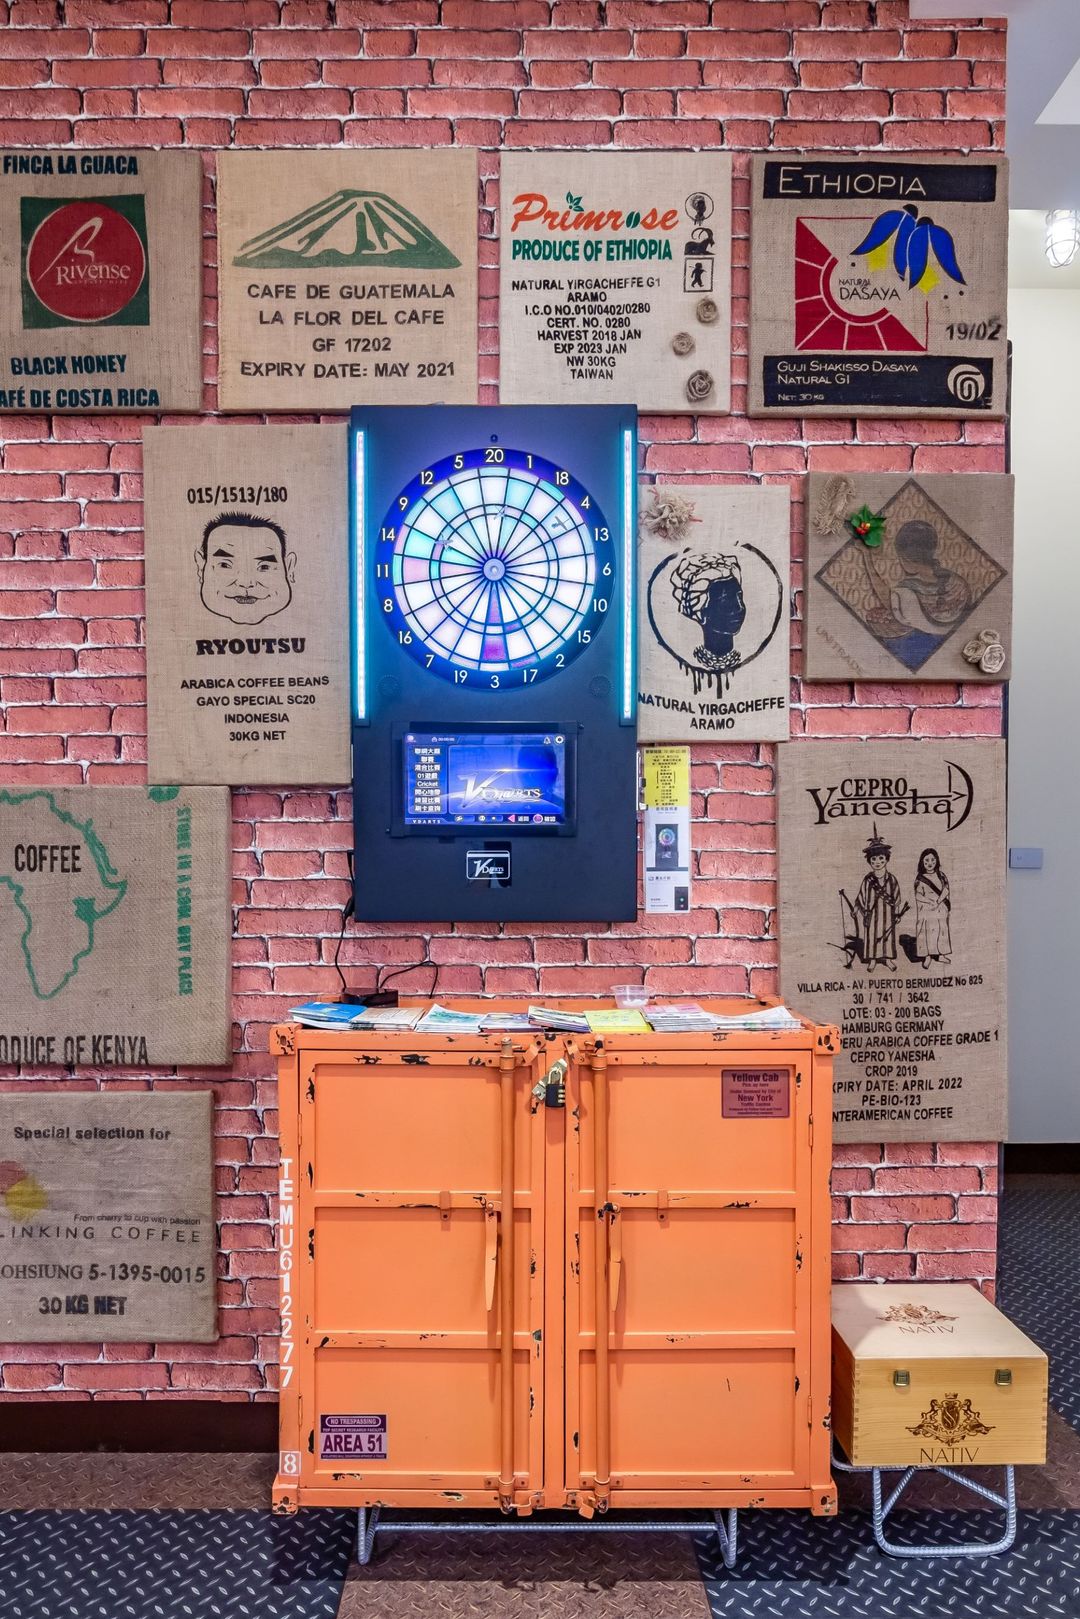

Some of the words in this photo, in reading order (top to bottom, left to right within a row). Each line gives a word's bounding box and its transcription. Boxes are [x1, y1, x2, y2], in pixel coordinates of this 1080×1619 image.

[3, 156, 53, 175] FINCA
[58, 156, 77, 174] LA
[81, 156, 138, 175] GUACA
[511, 193, 679, 231] Primrose
[512, 240, 580, 260] PRODUCE
[584, 241, 601, 261] OF
[606, 240, 672, 261] ETHIOPIA
[56, 259, 131, 285] Rivense
[512, 279, 564, 291] NATURAL
[568, 278, 644, 290] YIRGACHEFFE
[647, 277, 660, 287] G1
[839, 278, 870, 286] NATURAL
[248, 284, 296, 299] CAFE
[306, 285, 330, 299] DE
[340, 284, 455, 299] GUATEMALA
[568, 292, 607, 302] ARAMO
[840, 287, 900, 300] DASAYA
[260, 311, 283, 324] LA
[294, 311, 341, 325] FLOR
[352, 311, 387, 325] DEL
[395, 310, 444, 324] CAFE
[547, 318, 579, 328] CERT.
[583, 318, 602, 328] NO.
[605, 317, 630, 327] 0280
[538, 330, 588, 341] HARVEST
[593, 331, 616, 341] 2018
[621, 329, 641, 340] JAN
[313, 338, 335, 352] GF
[345, 338, 391, 352] 17202
[554, 343, 574, 354] EXP
[578, 343, 602, 354] 2023
[606, 343, 626, 354] JAN
[11, 357, 68, 375] BLACK
[72, 355, 126, 373] HONEY
[567, 357, 584, 366] NW
[588, 357, 616, 367] 30KG
[241, 362, 305, 376] EXPIRY
[314, 363, 368, 378] DATE:
[375, 363, 410, 377] MAY
[417, 362, 454, 378] 2021
[571, 369, 613, 380] TAIWAN
[30, 390, 50, 407] DE
[56, 389, 113, 407] COSTA
[121, 389, 159, 406] RICA
[455, 456, 463, 469] 5
[485, 450, 503, 462] 20
[421, 472, 433, 484] 12
[556, 472, 568, 485] 18
[187, 485, 287, 505] 015/1513/180
[400, 498, 408, 510] 9
[581, 497, 590, 508] 4
[382, 529, 395, 541] 14
[595, 529, 608, 541] 13
[377, 565, 388, 577] 11
[603, 563, 611, 576] 6
[384, 599, 392, 613] 8
[593, 599, 607, 612] 10
[399, 631, 412, 643] 16
[578, 631, 590, 643] 15
[196, 638, 305, 655] RYOUTSU
[426, 655, 434, 667] 7
[556, 655, 564, 667] 2
[181, 678, 235, 689] ARABICA
[238, 678, 284, 688] COFFEE
[289, 676, 329, 686] BEANS
[455, 671, 468, 683] 19
[491, 676, 499, 688] 3
[524, 670, 538, 683] 17
[197, 696, 229, 706] GAYO
[234, 695, 283, 706] SPECIAL
[287, 695, 315, 705] SC20
[638, 693, 695, 714] NATURAL
[698, 697, 785, 715] YIRGACHEFFE
[225, 713, 289, 723] INDONESIA
[690, 718, 734, 729] ARAMO
[230, 731, 259, 741] 30KG
[264, 731, 286, 740] NET
[841, 778, 907, 798] CEPRO
[806, 786, 954, 824] Yanesha
[176, 807, 192, 849] STORE
[15, 844, 81, 872] COFFEE
[176, 855, 192, 870] IN
[176, 874, 192, 884] A
[798, 982, 822, 993] VILLA
[825, 981, 844, 992] RICA
[869, 979, 903, 989] PUERTO
[906, 977, 953, 989] BERMUDEZ
[969, 975, 983, 985] 825
[853, 994, 863, 1004] 30
[878, 993, 893, 1004] 741
[908, 992, 929, 1002] 3642
[843, 1008, 872, 1020] LOTE:
[875, 1007, 886, 1018] 03
[895, 1007, 910, 1018] 200
[914, 1006, 941, 1018] BAGS
[842, 1022, 892, 1034] HAMBURG
[895, 1020, 944, 1032] GERMANY
[865, 1037, 910, 1049] ARABICA
[914, 1034, 952, 1047] COFFEE
[956, 1031, 990, 1044] GRADE
[64, 1036, 85, 1064] OF
[92, 1035, 148, 1064] KENYA
[851, 1052, 885, 1063] CEPRO
[889, 1050, 935, 1062] YANESHA
[731, 1073, 760, 1082] Yellow
[762, 1073, 779, 1081] Cab
[865, 1066, 893, 1077] CROP
[897, 1066, 917, 1076] 2019
[833, 1082, 862, 1094] PIRY
[866, 1080, 899, 1092] DATE:
[902, 1079, 934, 1091] APRIL
[939, 1078, 962, 1089] 2022
[862, 1095, 921, 1106] PE-BIO-123
[832, 1109, 910, 1122] NTERAMERICAN
[914, 1107, 953, 1118] COFFEE
[14, 1127, 69, 1141] Special
[76, 1127, 144, 1140] selection
[150, 1127, 171, 1140] for
[0, 1226, 95, 1239] INKING
[112, 1226, 200, 1243] COFFEE
[0, 1264, 82, 1279] OHSIUNG
[89, 1263, 206, 1283] 5-1395-0015
[39, 1297, 62, 1314] 30
[65, 1295, 89, 1314] KG
[94, 1296, 127, 1315] NET
[899, 1326, 954, 1334] NATIV
[323, 1435, 363, 1451] AREA
[368, 1435, 382, 1451] 51
[920, 1448, 979, 1463] NATIV
[284, 1454, 296, 1473] 8
